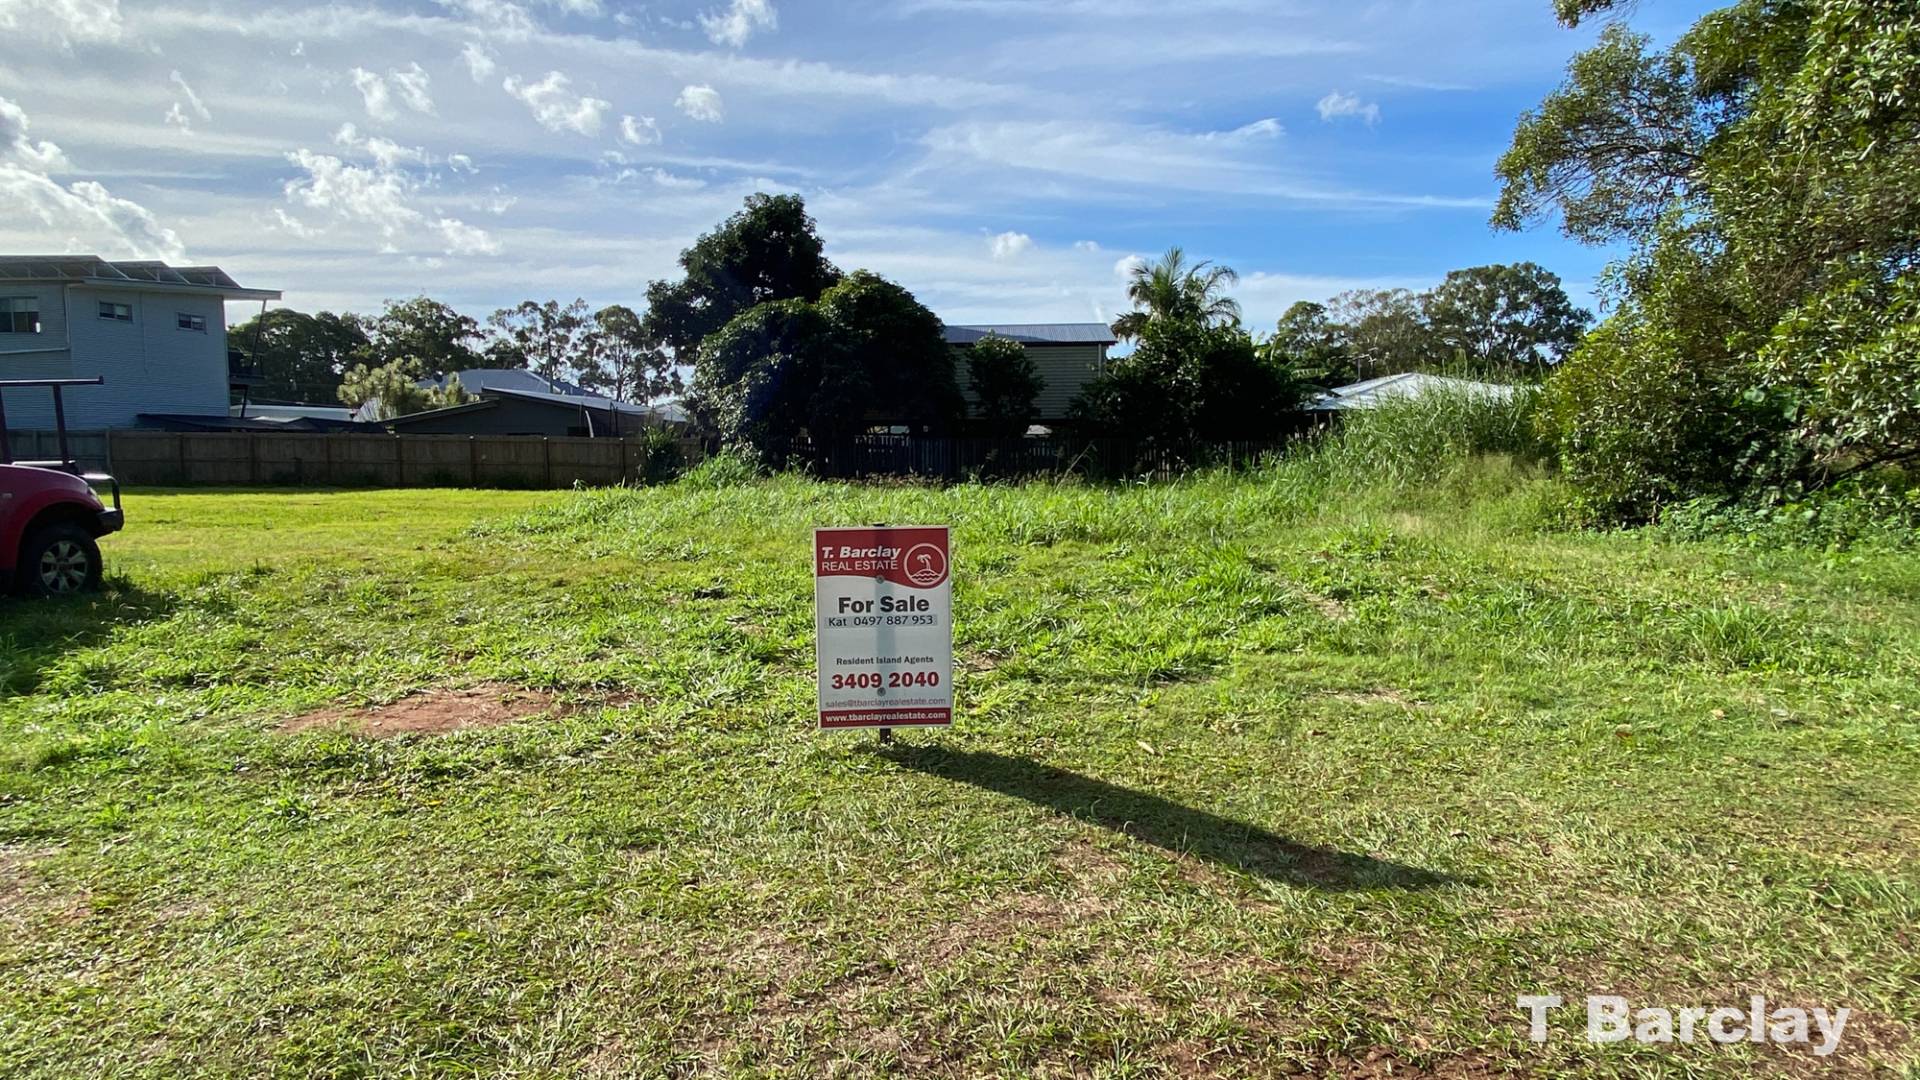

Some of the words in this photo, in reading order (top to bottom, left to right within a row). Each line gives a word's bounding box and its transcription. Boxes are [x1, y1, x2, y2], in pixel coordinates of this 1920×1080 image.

[822, 546, 834, 559] T.
[839, 545, 901, 561] Barclay
[822, 561, 853, 571] REAL
[855, 560, 898, 571] ESTATE
[838, 597, 874, 614] For
[880, 596, 930, 613] Sale
[828, 617, 847, 627] Kat
[853, 616, 882, 626] 0497
[886, 616, 908, 625] 887
[912, 615, 933, 625] 953
[836, 657, 874, 665] Resident
[876, 656, 902, 664] Island
[904, 656, 934, 665] Agents
[831, 673, 882, 689] 3409
[888, 671, 940, 688] 2040
[825, 697, 946, 708] sales@tbarclayrealestate.com
[825, 711, 947, 723] www.tbarclayrealestate.com
